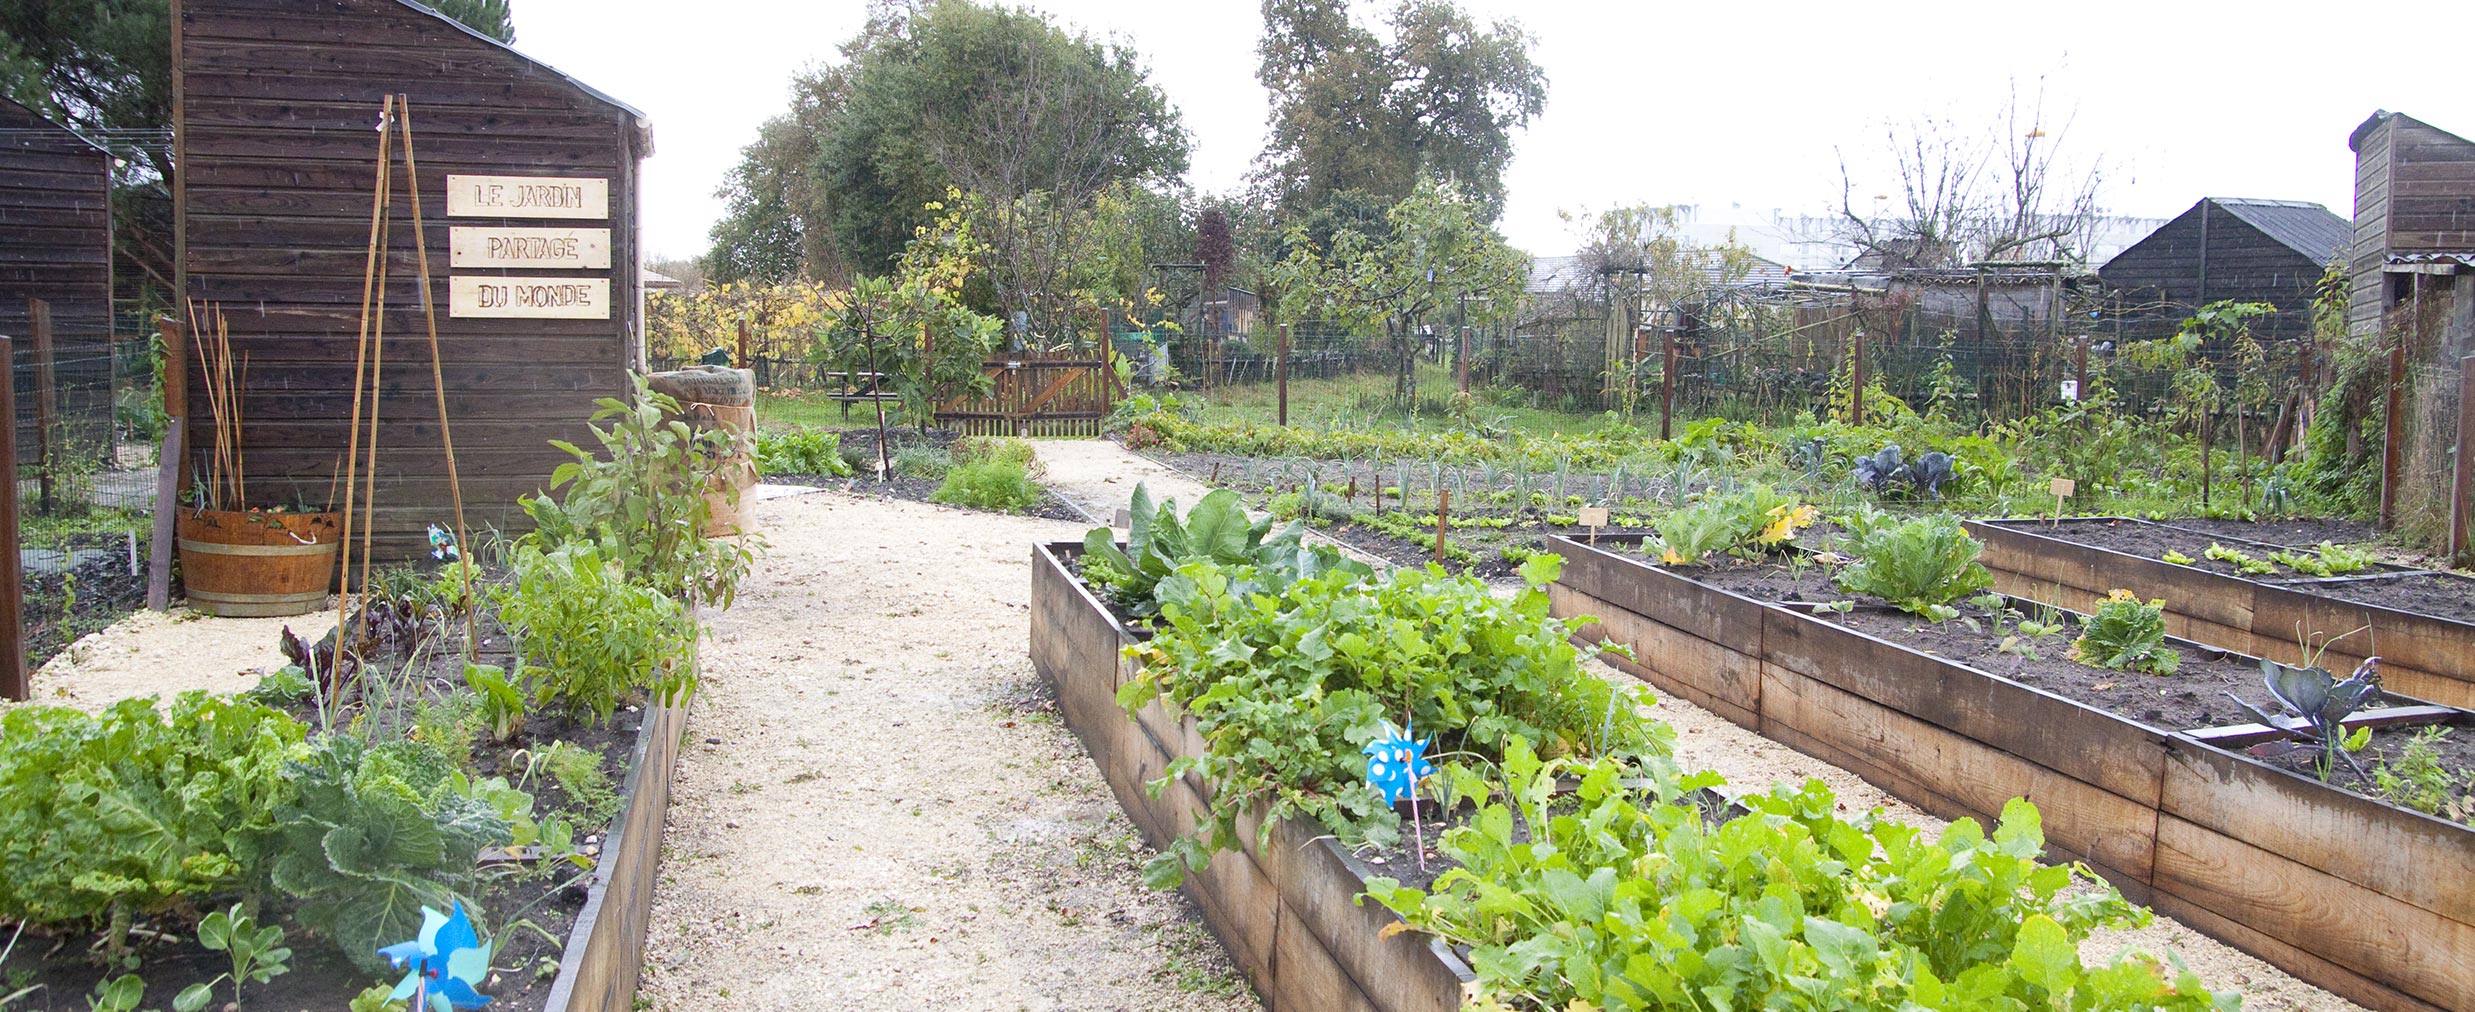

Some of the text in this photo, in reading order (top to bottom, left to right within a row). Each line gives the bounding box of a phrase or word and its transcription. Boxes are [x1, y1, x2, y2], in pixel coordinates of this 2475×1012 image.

[474, 185, 503, 206] LE
[488, 231, 578, 260] PARTAGÉ
[478, 284, 591, 308] DU MONDE
